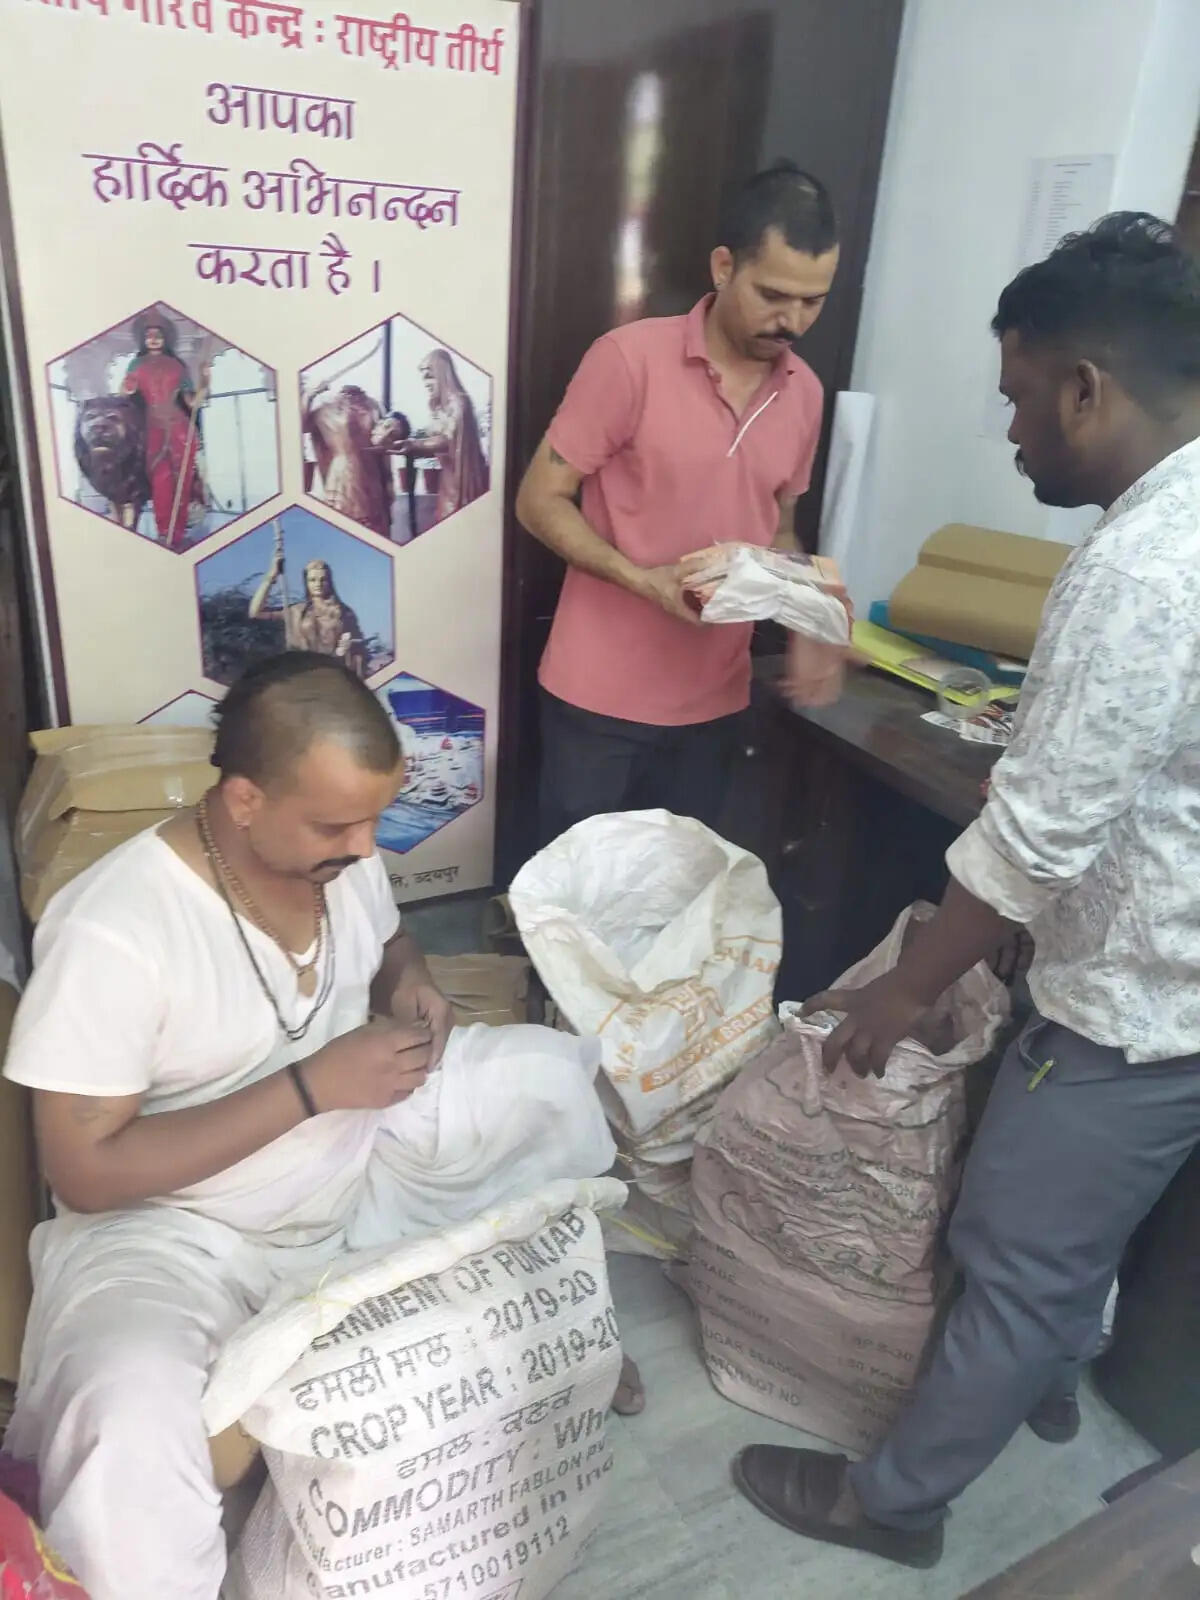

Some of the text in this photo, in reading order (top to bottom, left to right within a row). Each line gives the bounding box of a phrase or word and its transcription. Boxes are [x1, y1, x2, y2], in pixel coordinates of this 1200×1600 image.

[334, 12, 440, 71] राष्ट्रीय
[445, 23, 505, 75] तीर्थ
[205, 82, 356, 140] आपका
[81, 142, 463, 229] हार्दिक अभिनन्दन
[187, 242, 310, 289] करता
[319, 232, 352, 295] है
[454, 1257, 494, 1295] OF
[492, 1209, 586, 1278] PUNJAB
[482, 1269, 598, 1340] 2019-20
[311, 1404, 408, 1460] CROP
[413, 1366, 503, 1431] YEAR
[520, 1305, 621, 1385] 2019-20
[553, 1407, 607, 1450] Wh
[539, 1488, 567, 1514] in
